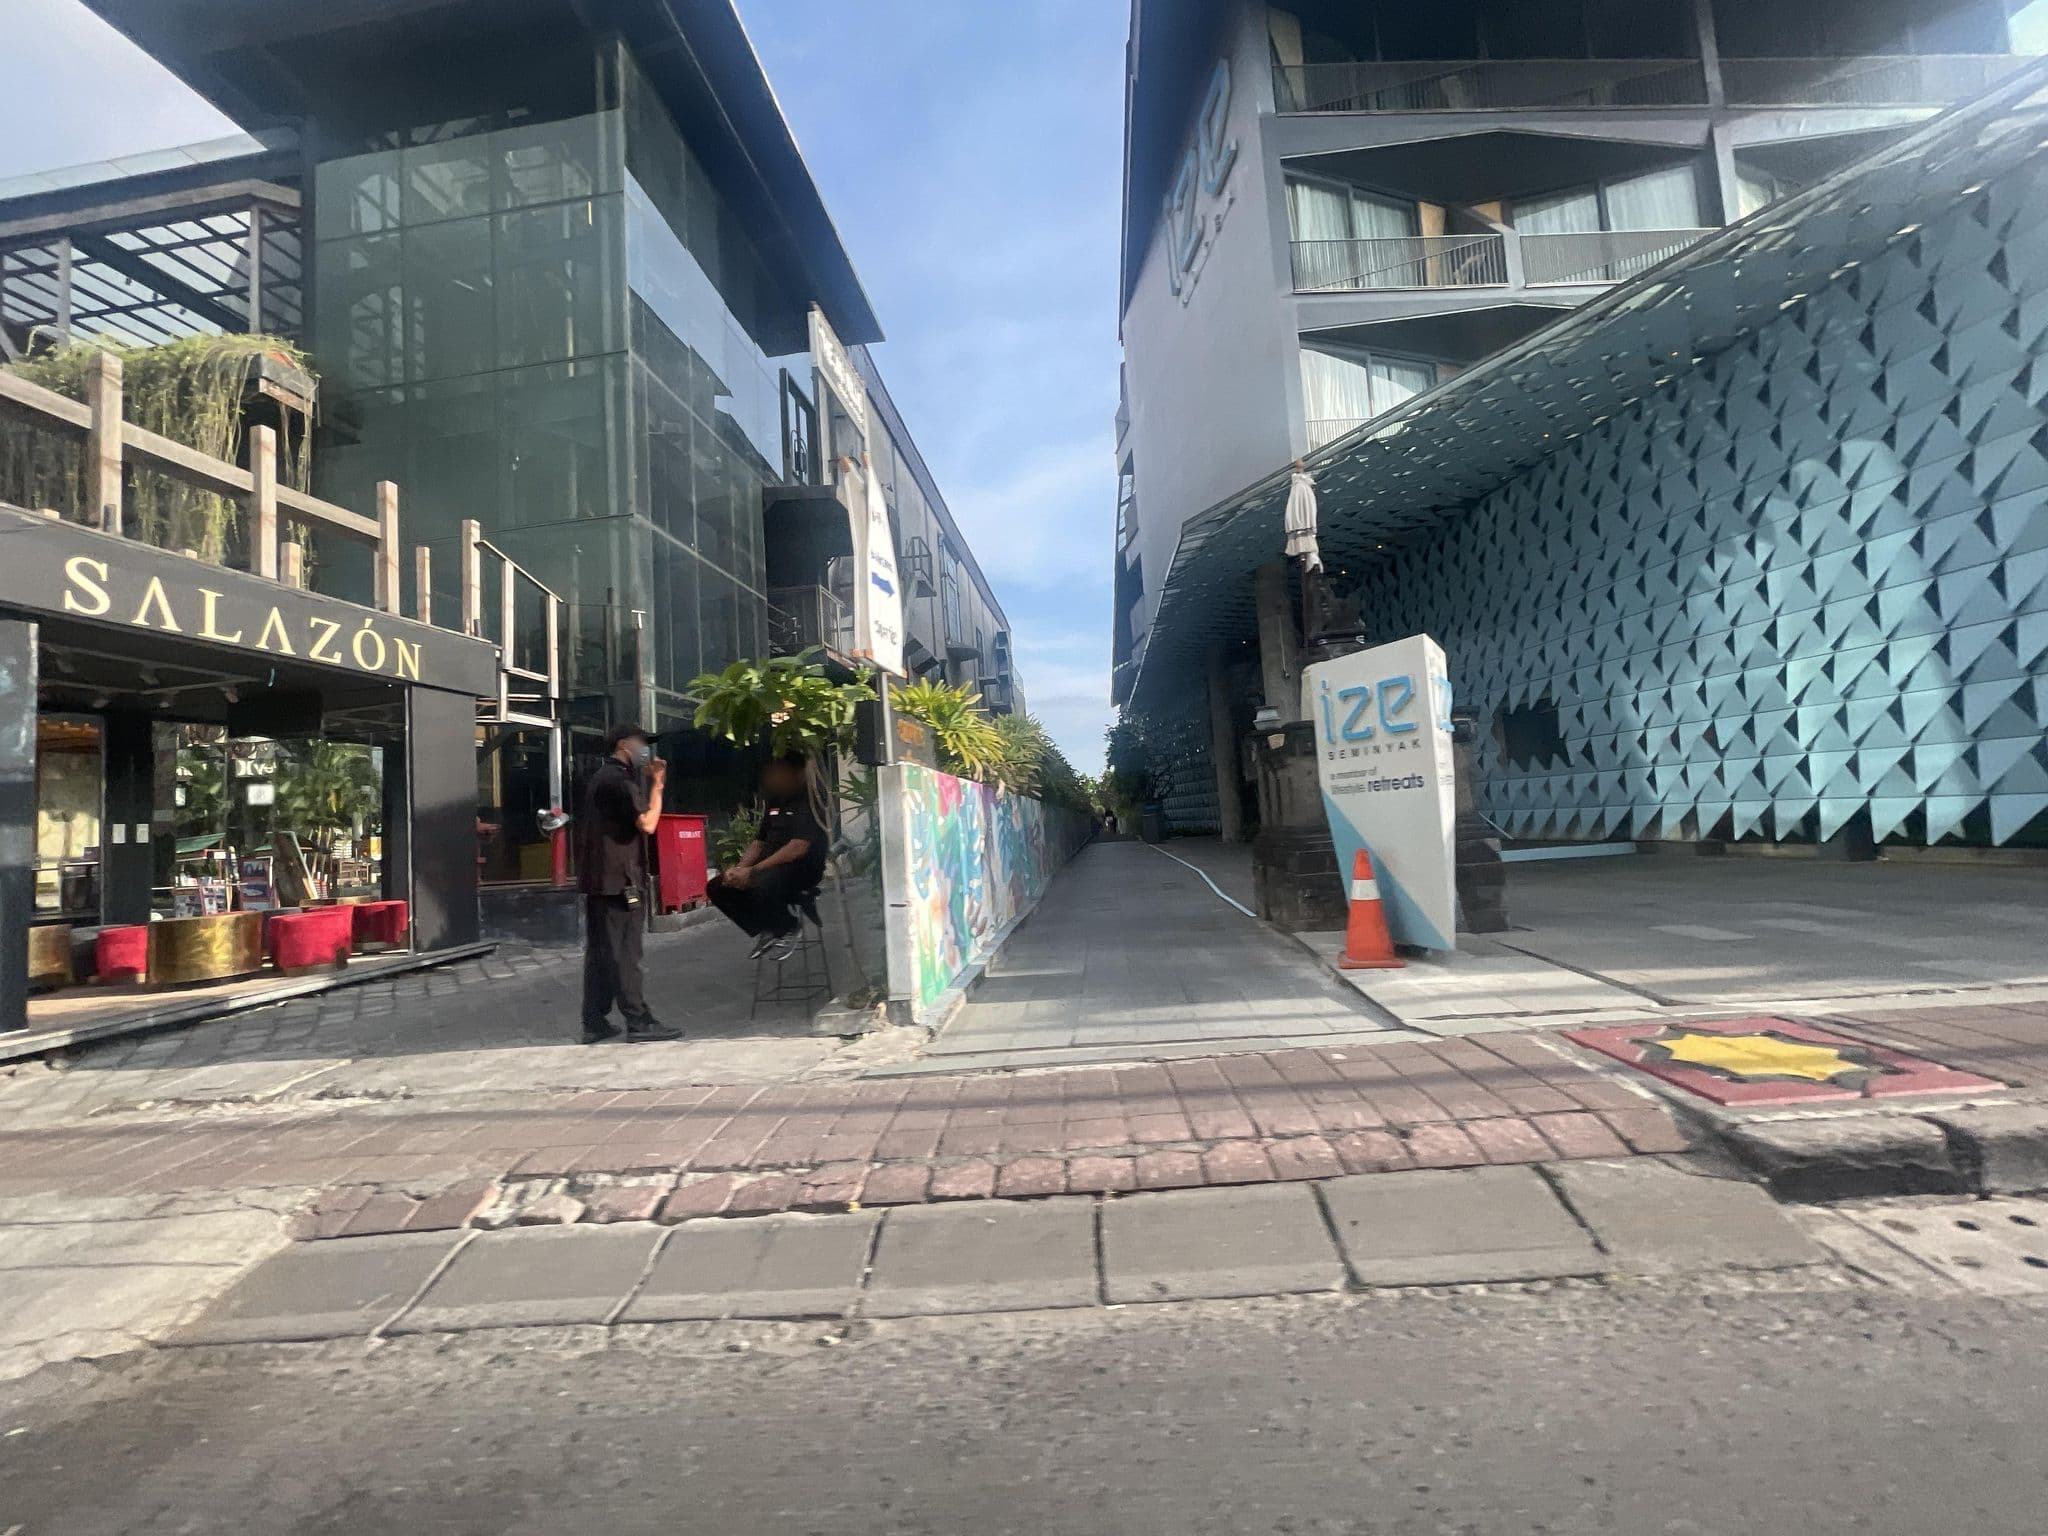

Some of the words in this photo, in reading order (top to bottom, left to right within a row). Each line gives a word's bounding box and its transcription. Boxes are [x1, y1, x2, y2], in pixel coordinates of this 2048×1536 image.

[1320, 675, 1419, 744] ize
[1328, 738, 1421, 760] SEMINYAK
[1368, 773, 1424, 792] retreats
